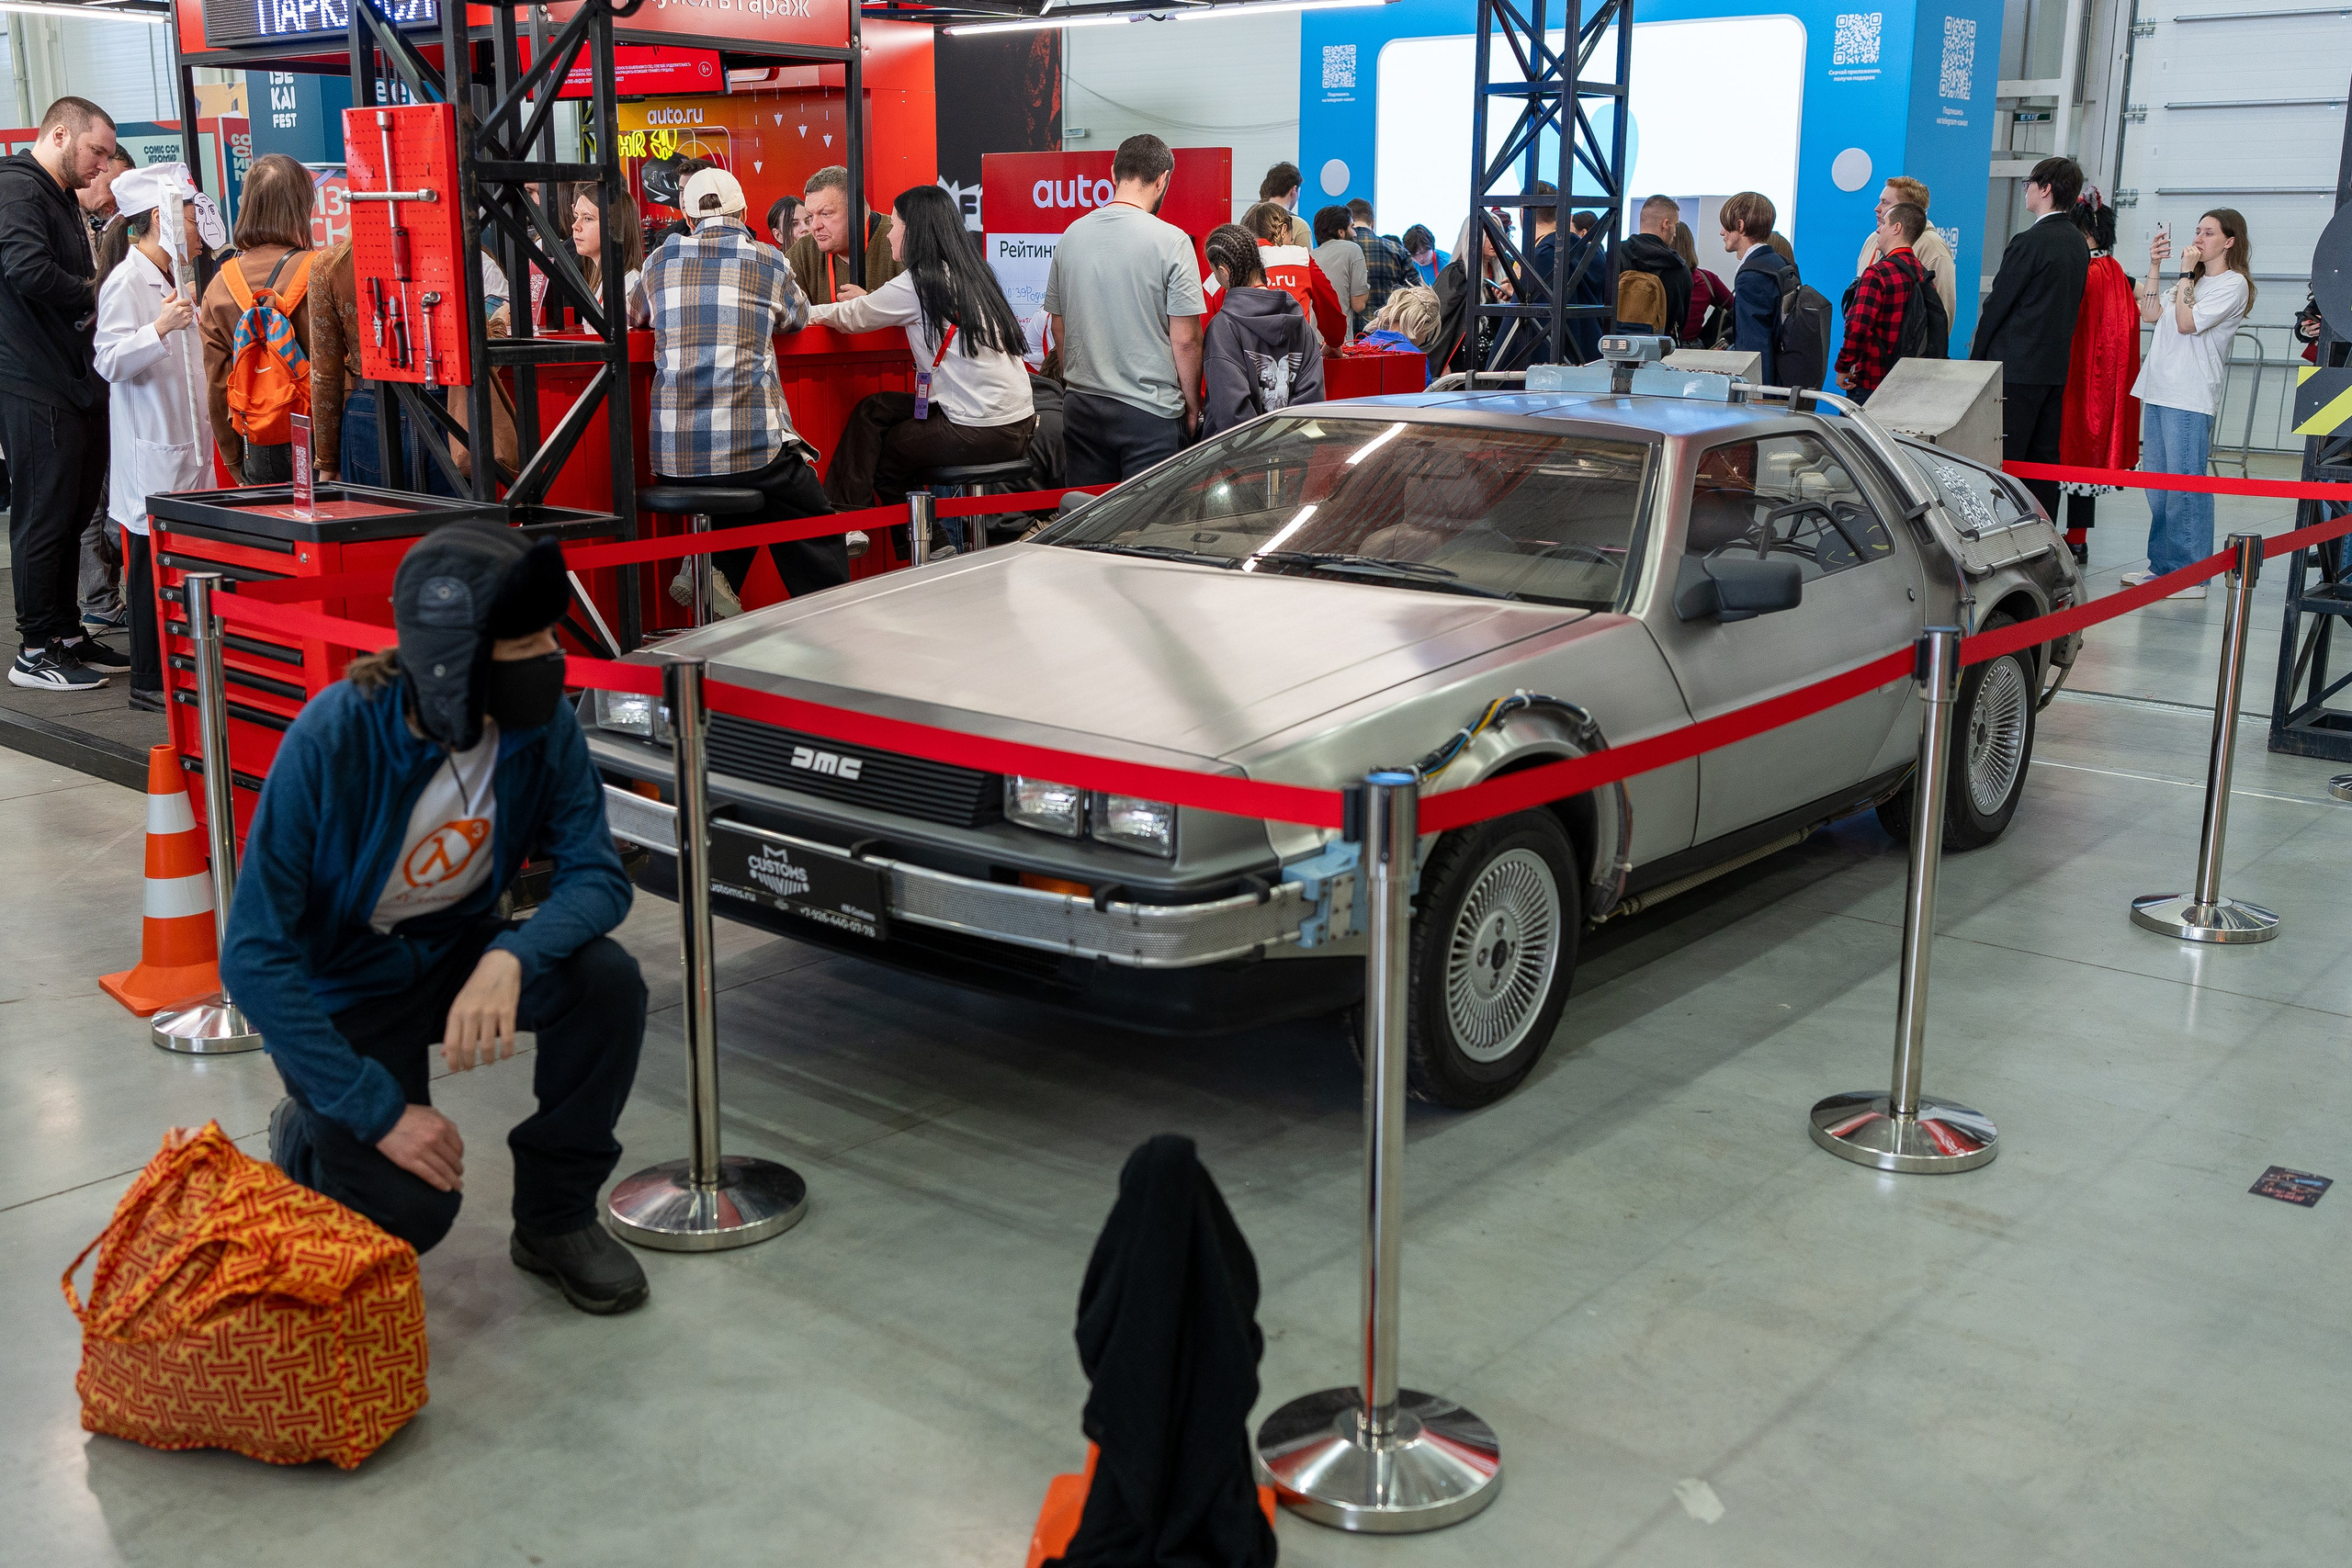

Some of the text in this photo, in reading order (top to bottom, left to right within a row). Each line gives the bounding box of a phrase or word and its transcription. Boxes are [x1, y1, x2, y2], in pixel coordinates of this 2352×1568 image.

[270, 86, 297, 110] KAI
[273, 113, 297, 128] FEST
[647, 106, 705, 125] auto.ru
[143, 144, 180, 154] COMIC CON
[790, 746, 864, 781] DMC
[748, 854, 808, 882] CUSTOMS
